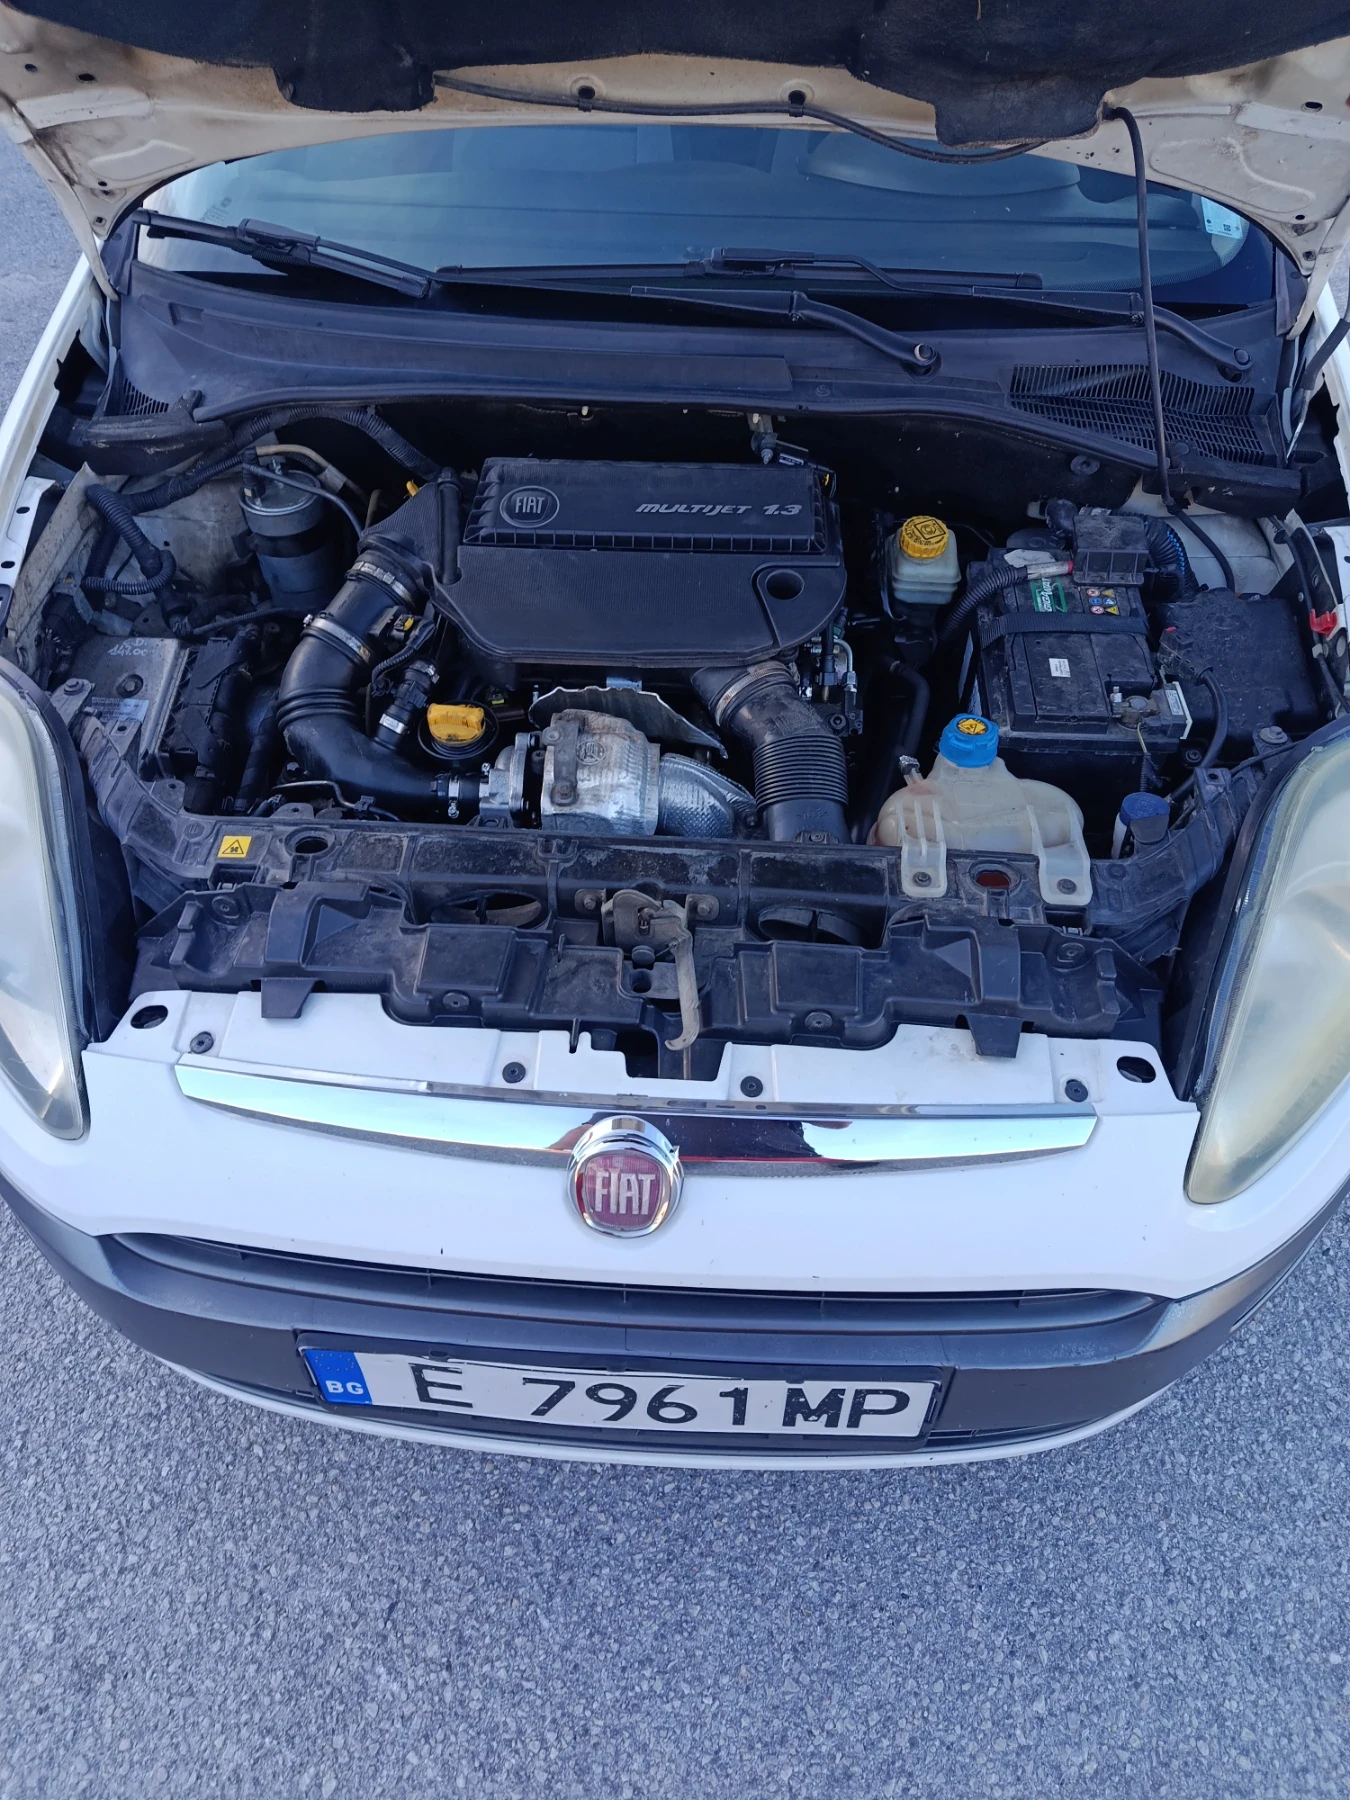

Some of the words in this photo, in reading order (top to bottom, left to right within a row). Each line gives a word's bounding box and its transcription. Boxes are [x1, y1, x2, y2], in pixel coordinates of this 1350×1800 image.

[515, 496, 545, 515] FIAT
[636, 503, 752, 516] MULTIJET
[763, 503, 802, 516] 1.3
[594, 1167, 656, 1215] FIAT
[325, 1380, 364, 1395] BG
[408, 1362, 473, 1408] E
[521, 1376, 749, 1426] 7961
[782, 1387, 911, 1428] MP
